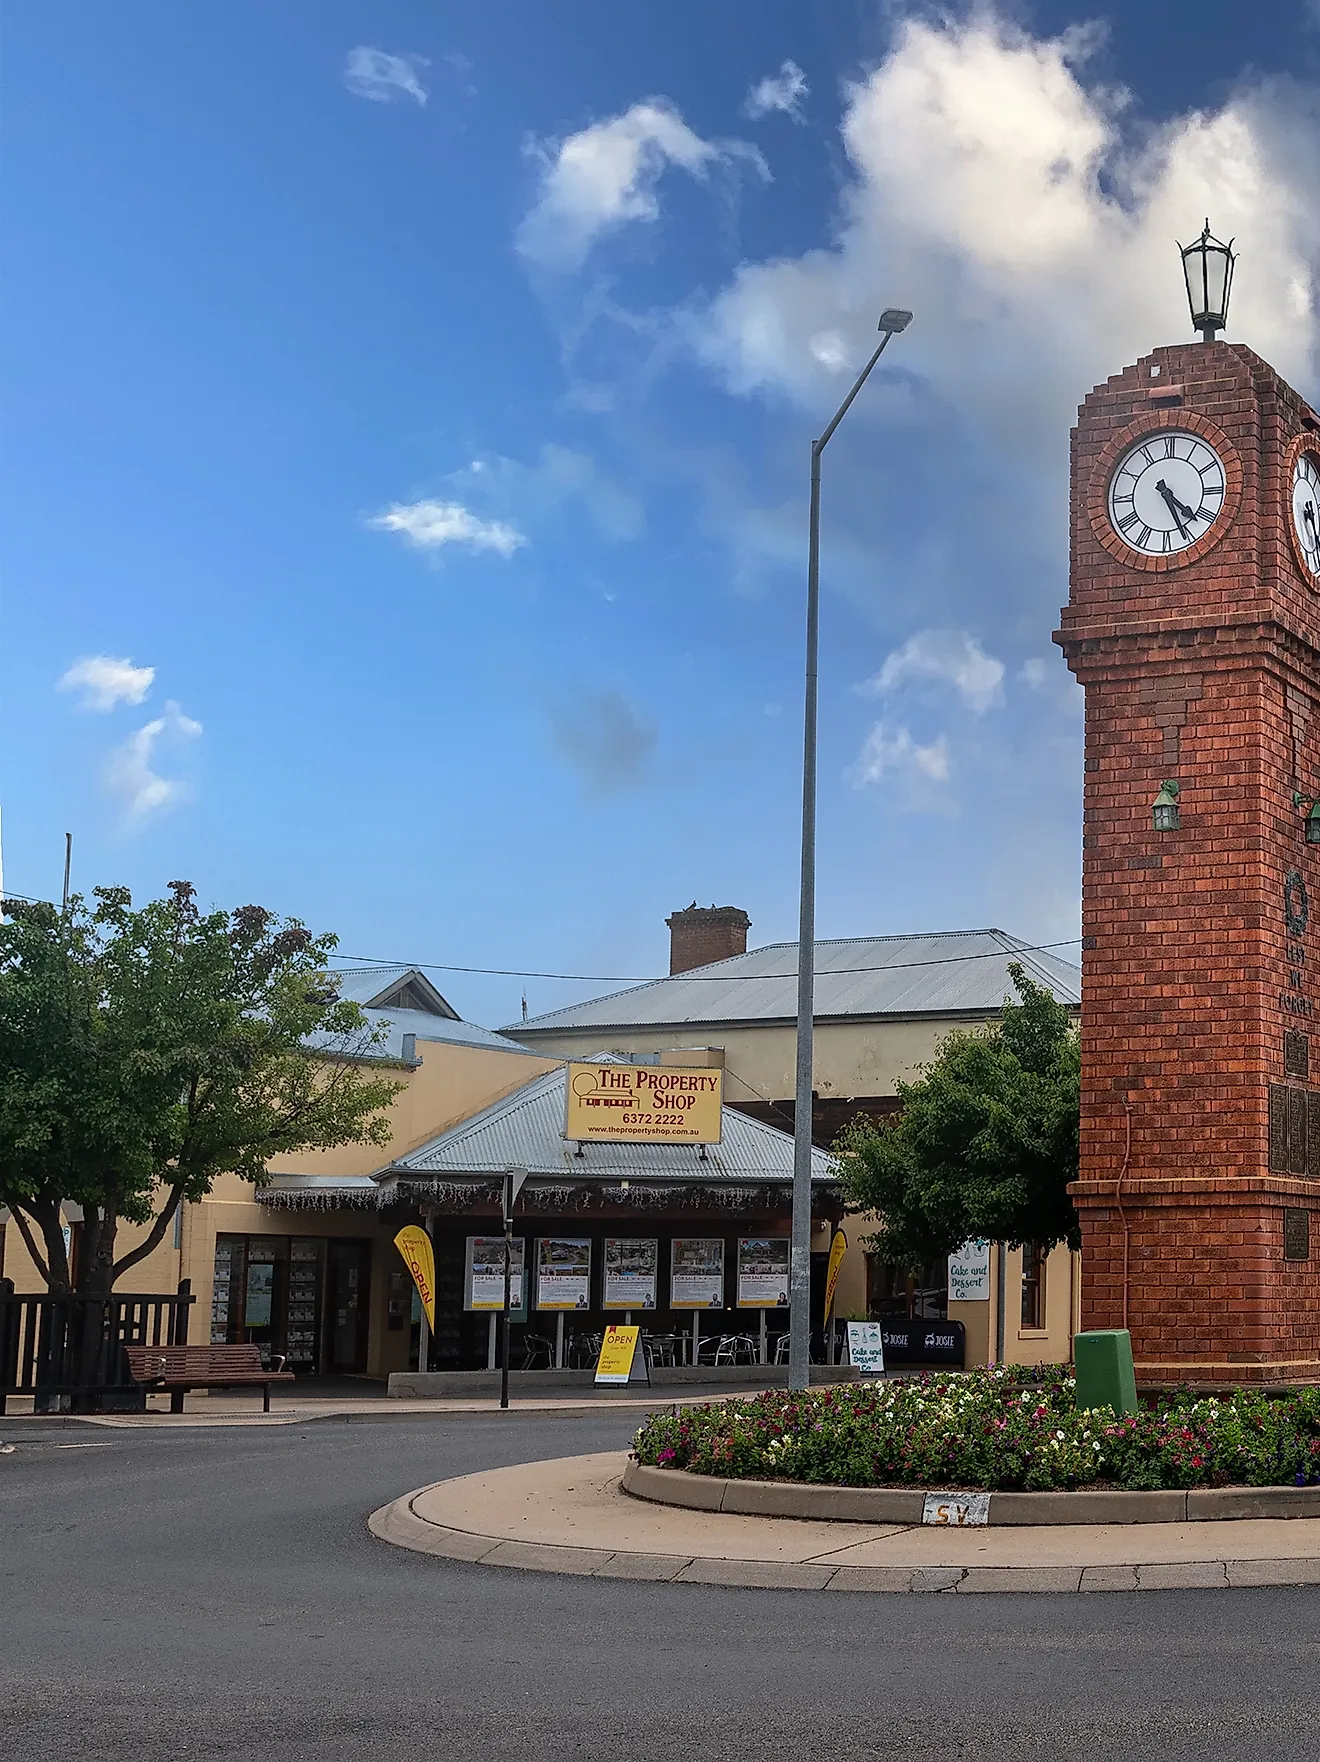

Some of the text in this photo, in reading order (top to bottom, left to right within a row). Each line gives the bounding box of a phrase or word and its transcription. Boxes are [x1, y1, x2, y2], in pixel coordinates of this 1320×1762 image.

[1286, 942, 1305, 964] LEST
[1290, 969, 1305, 988] WE
[1279, 992, 1313, 1018] FORGET
[598, 1069, 718, 1092] THE PROPERTY
[652, 1090, 696, 1110] SHOP
[622, 1113, 684, 1125] 6372 2222
[587, 1126, 699, 1136] www.thepropertyshop.com.au
[951, 1264, 987, 1276] Cake and
[411, 1261, 432, 1304] OPEN
[951, 1277, 983, 1288] Dessert
[955, 1288, 967, 1298] Co.
[607, 1335, 633, 1344] OPEN
[889, 1334, 908, 1345] JOSIE
[935, 1335, 954, 1346] JOSIE
[851, 1347, 882, 1356] Cake and
